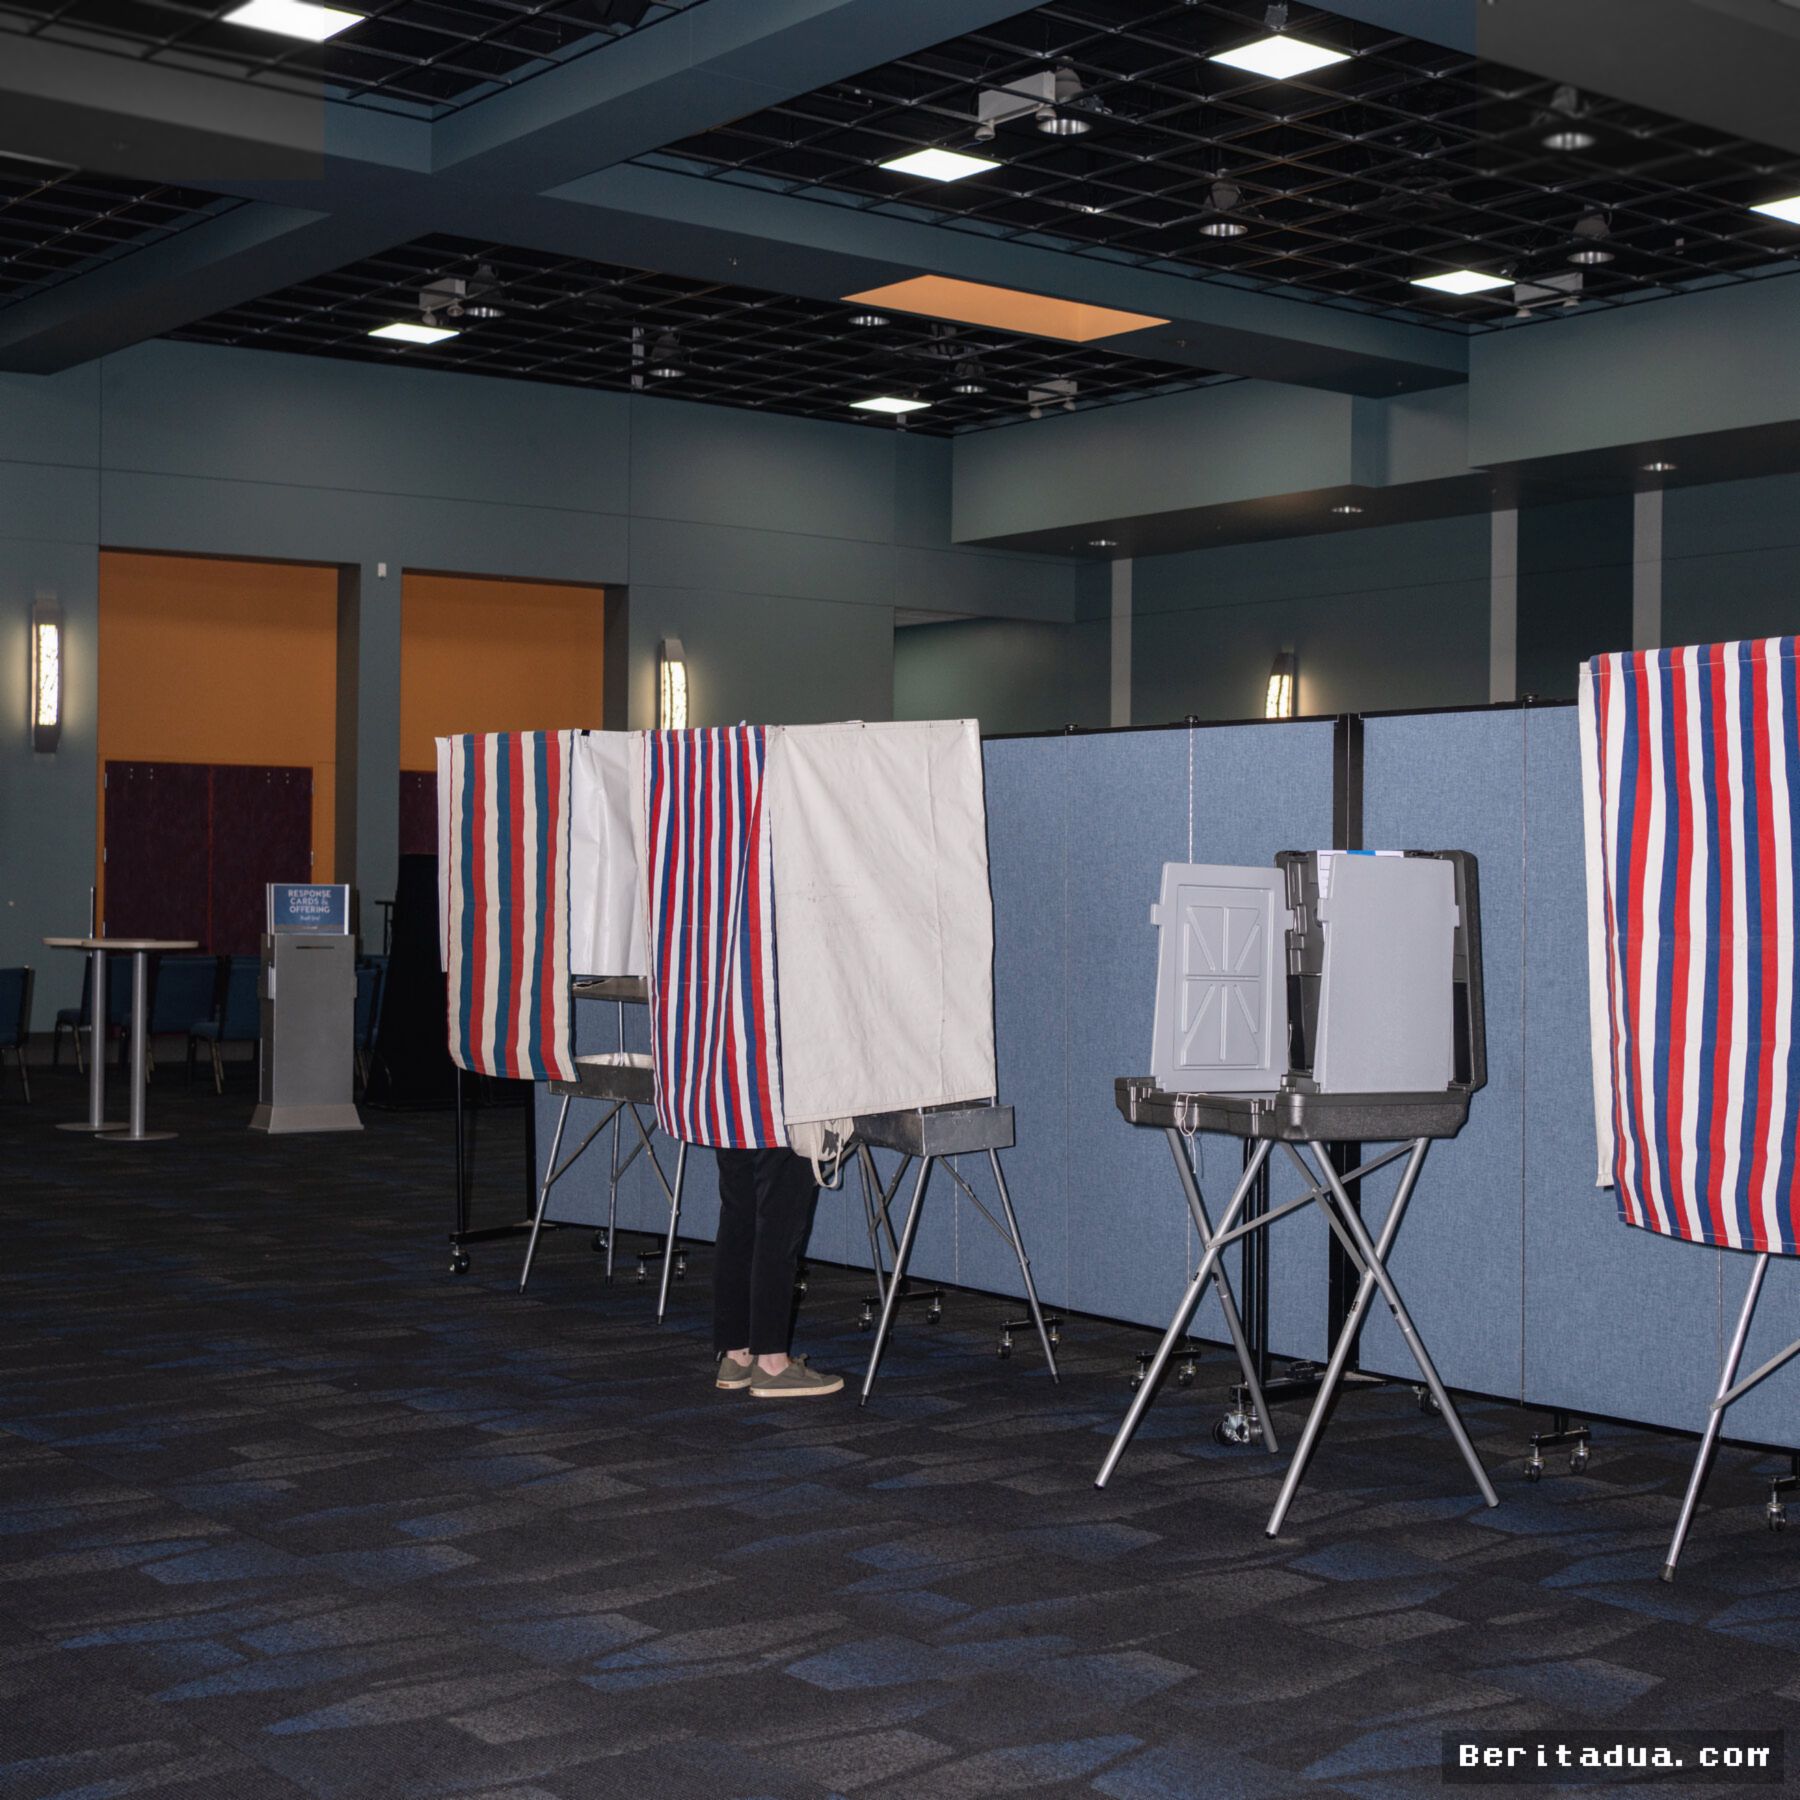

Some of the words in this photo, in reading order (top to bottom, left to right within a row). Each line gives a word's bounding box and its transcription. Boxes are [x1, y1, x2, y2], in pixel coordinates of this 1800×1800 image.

[288, 889, 332, 898] RESPONSE
[290, 897, 320, 905] CARDS
[289, 905, 331, 914] OFFERING
